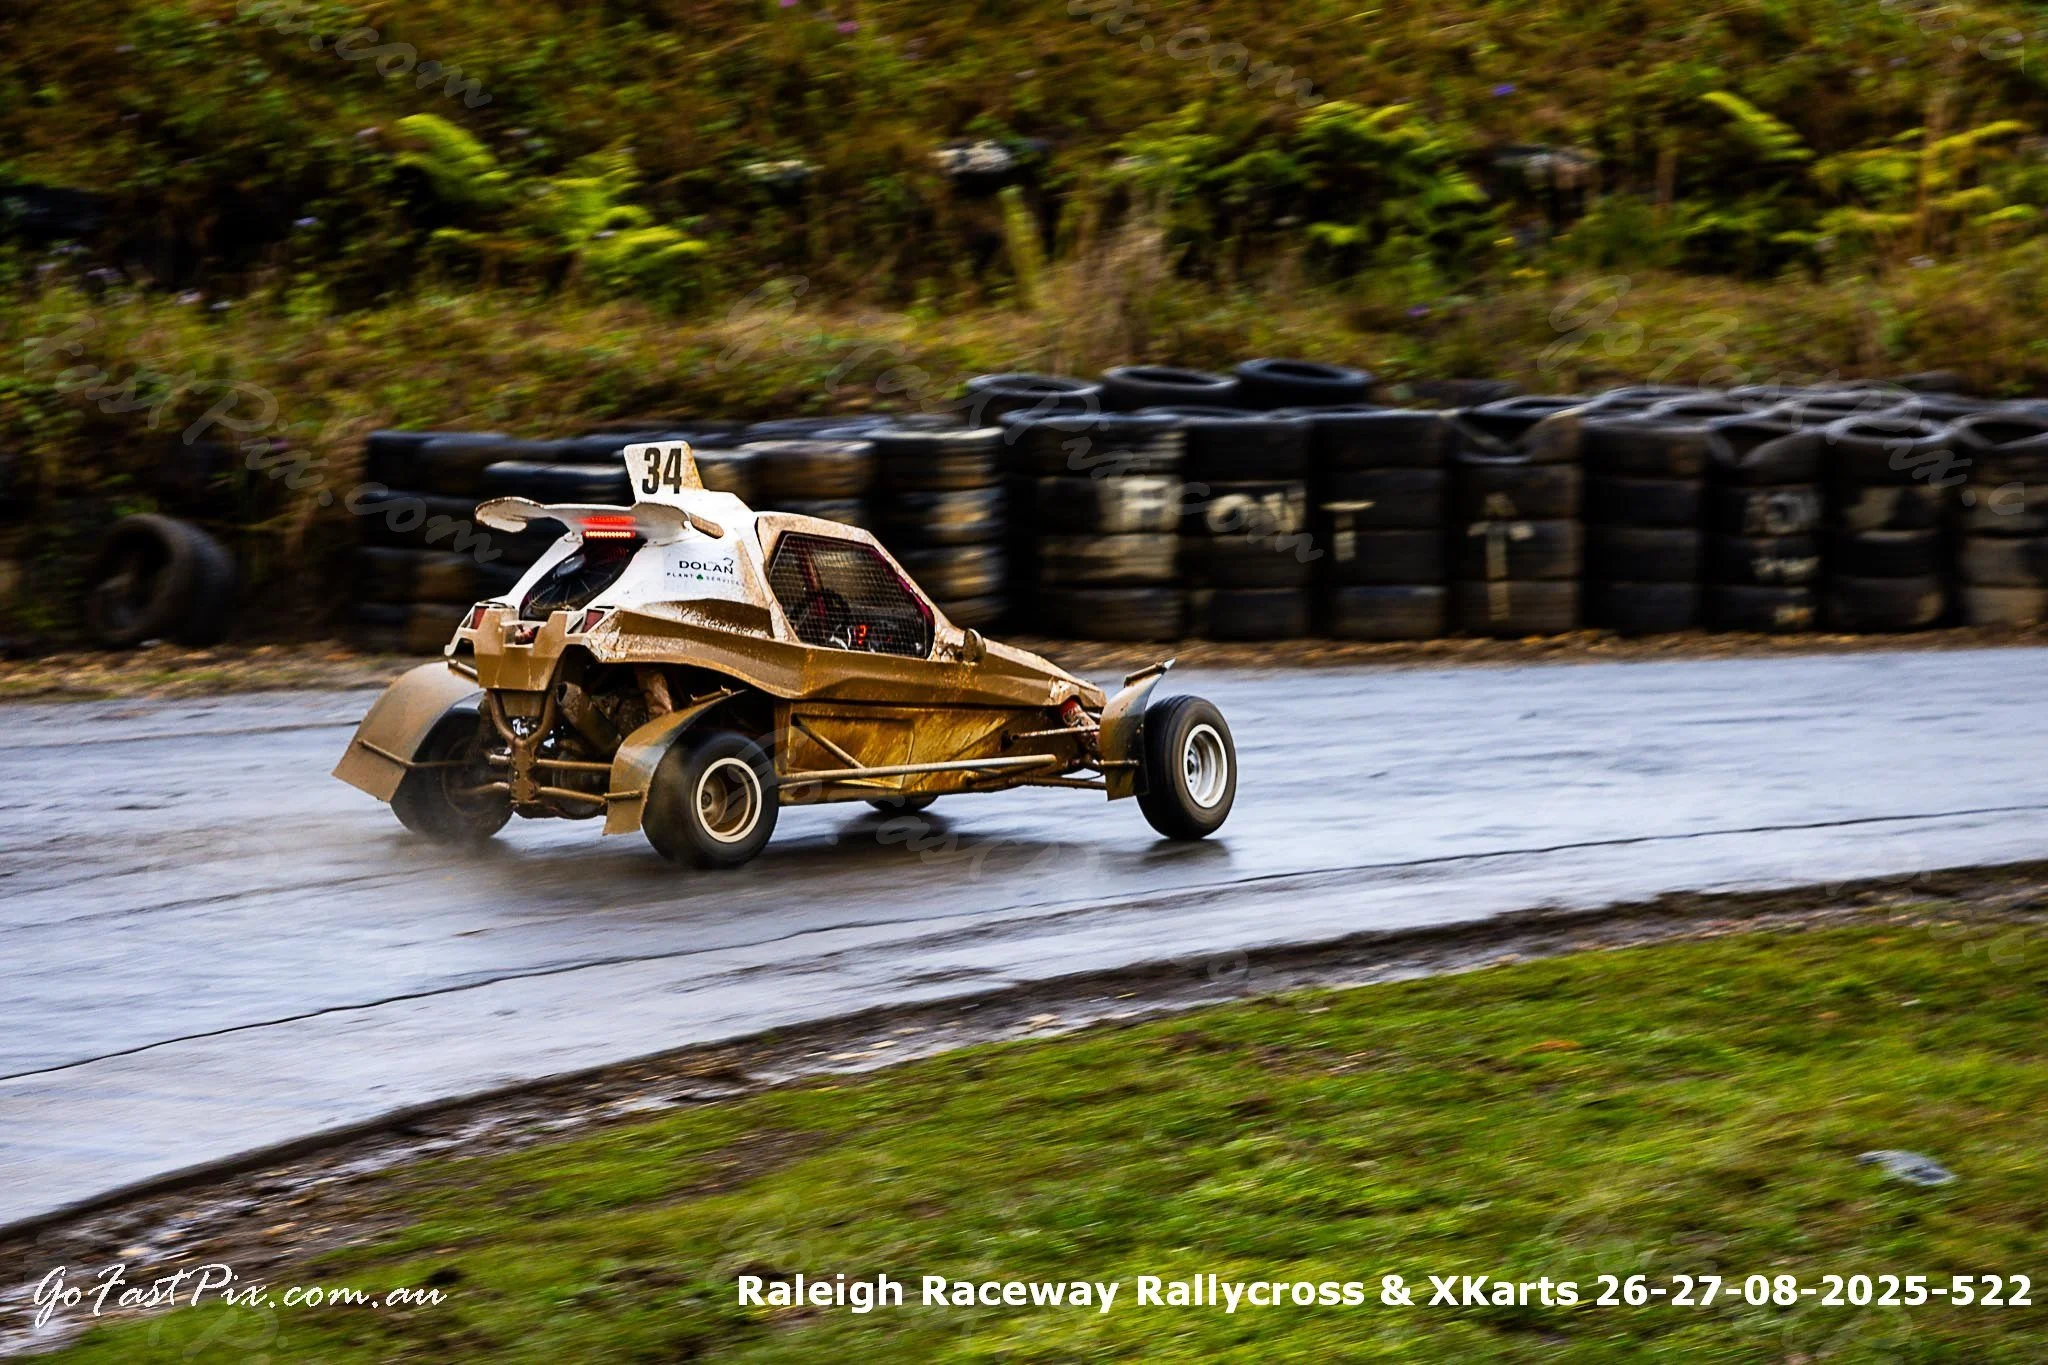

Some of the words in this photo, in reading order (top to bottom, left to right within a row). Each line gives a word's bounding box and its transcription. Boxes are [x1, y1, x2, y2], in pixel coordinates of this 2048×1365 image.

[642, 447, 682, 494] 34
[666, 571, 694, 579] PLANT
[679, 560, 734, 575] DOLAN
